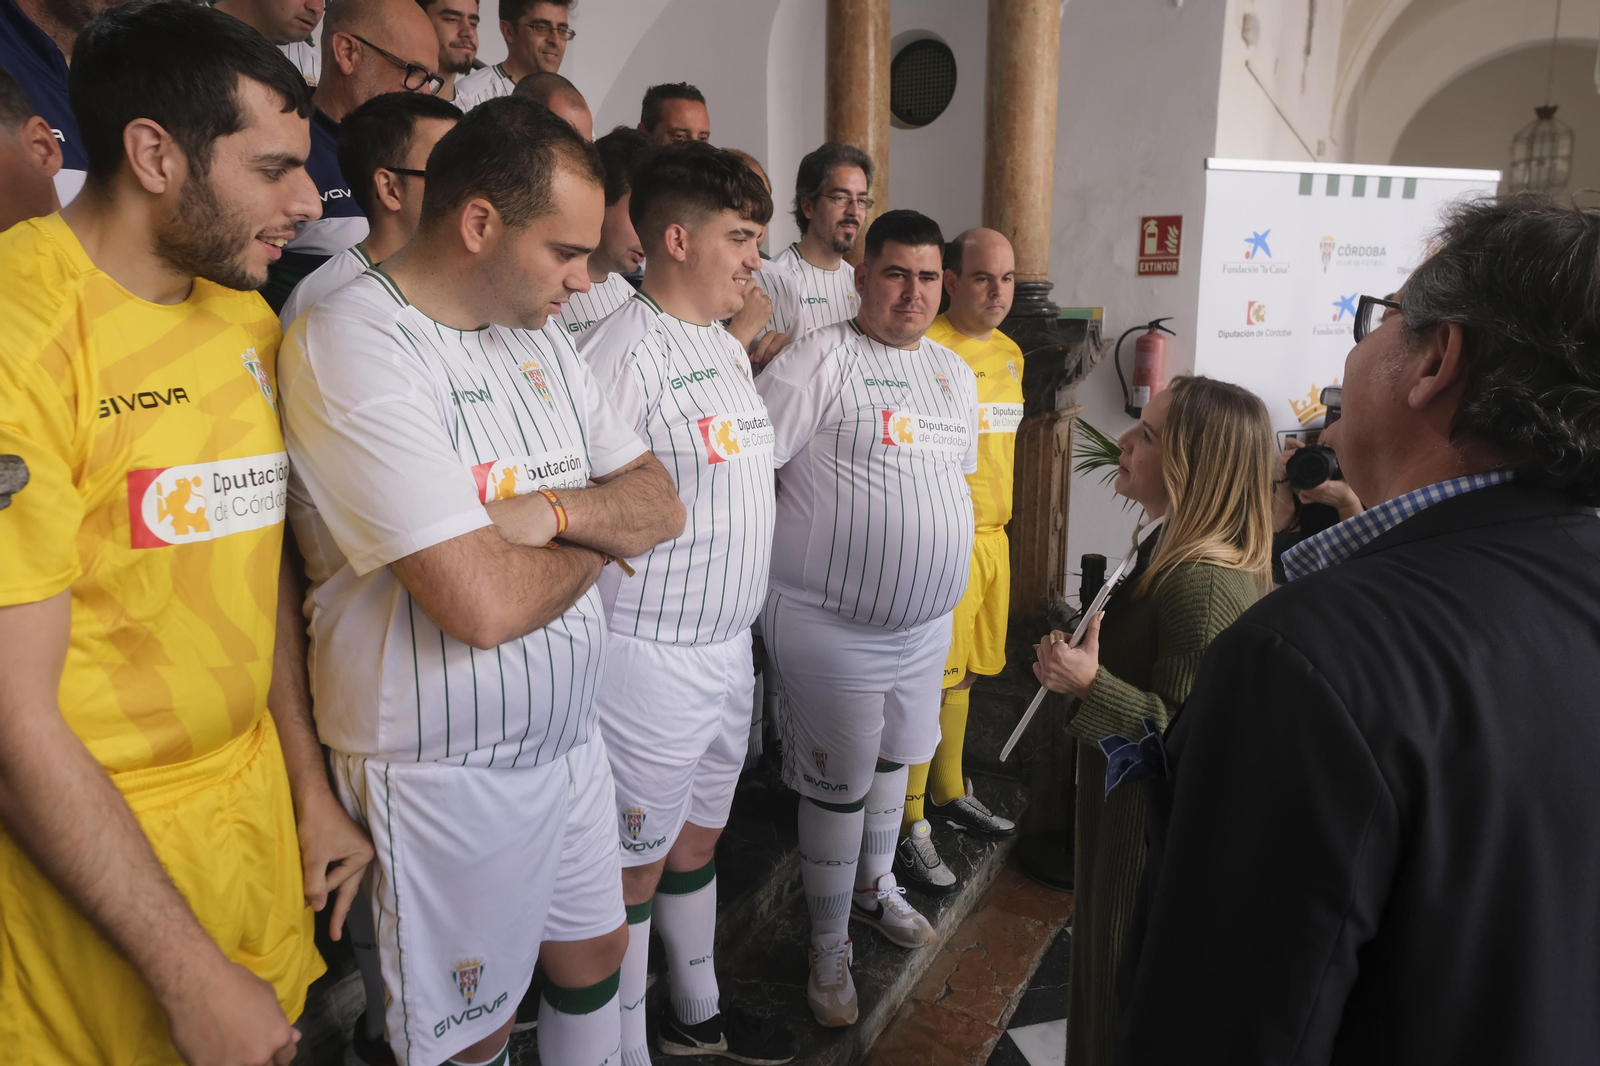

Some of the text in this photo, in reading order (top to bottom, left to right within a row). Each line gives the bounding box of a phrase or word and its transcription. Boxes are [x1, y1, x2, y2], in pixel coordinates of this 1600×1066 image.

[1139, 261, 1178, 272] EXTINTOR
[1222, 264, 1259, 274] Fundación
[1218, 329, 1254, 339] Diputación
[1265, 329, 1292, 337] Córdoba
[671, 368, 720, 390] GIVOVA
[866, 378, 909, 389] GIVOVA
[918, 418, 967, 434] Diputación
[919, 433, 968, 447] de Córdoba
[803, 773, 849, 792] GIVOVA
[434, 991, 508, 1039] GIVOVA
